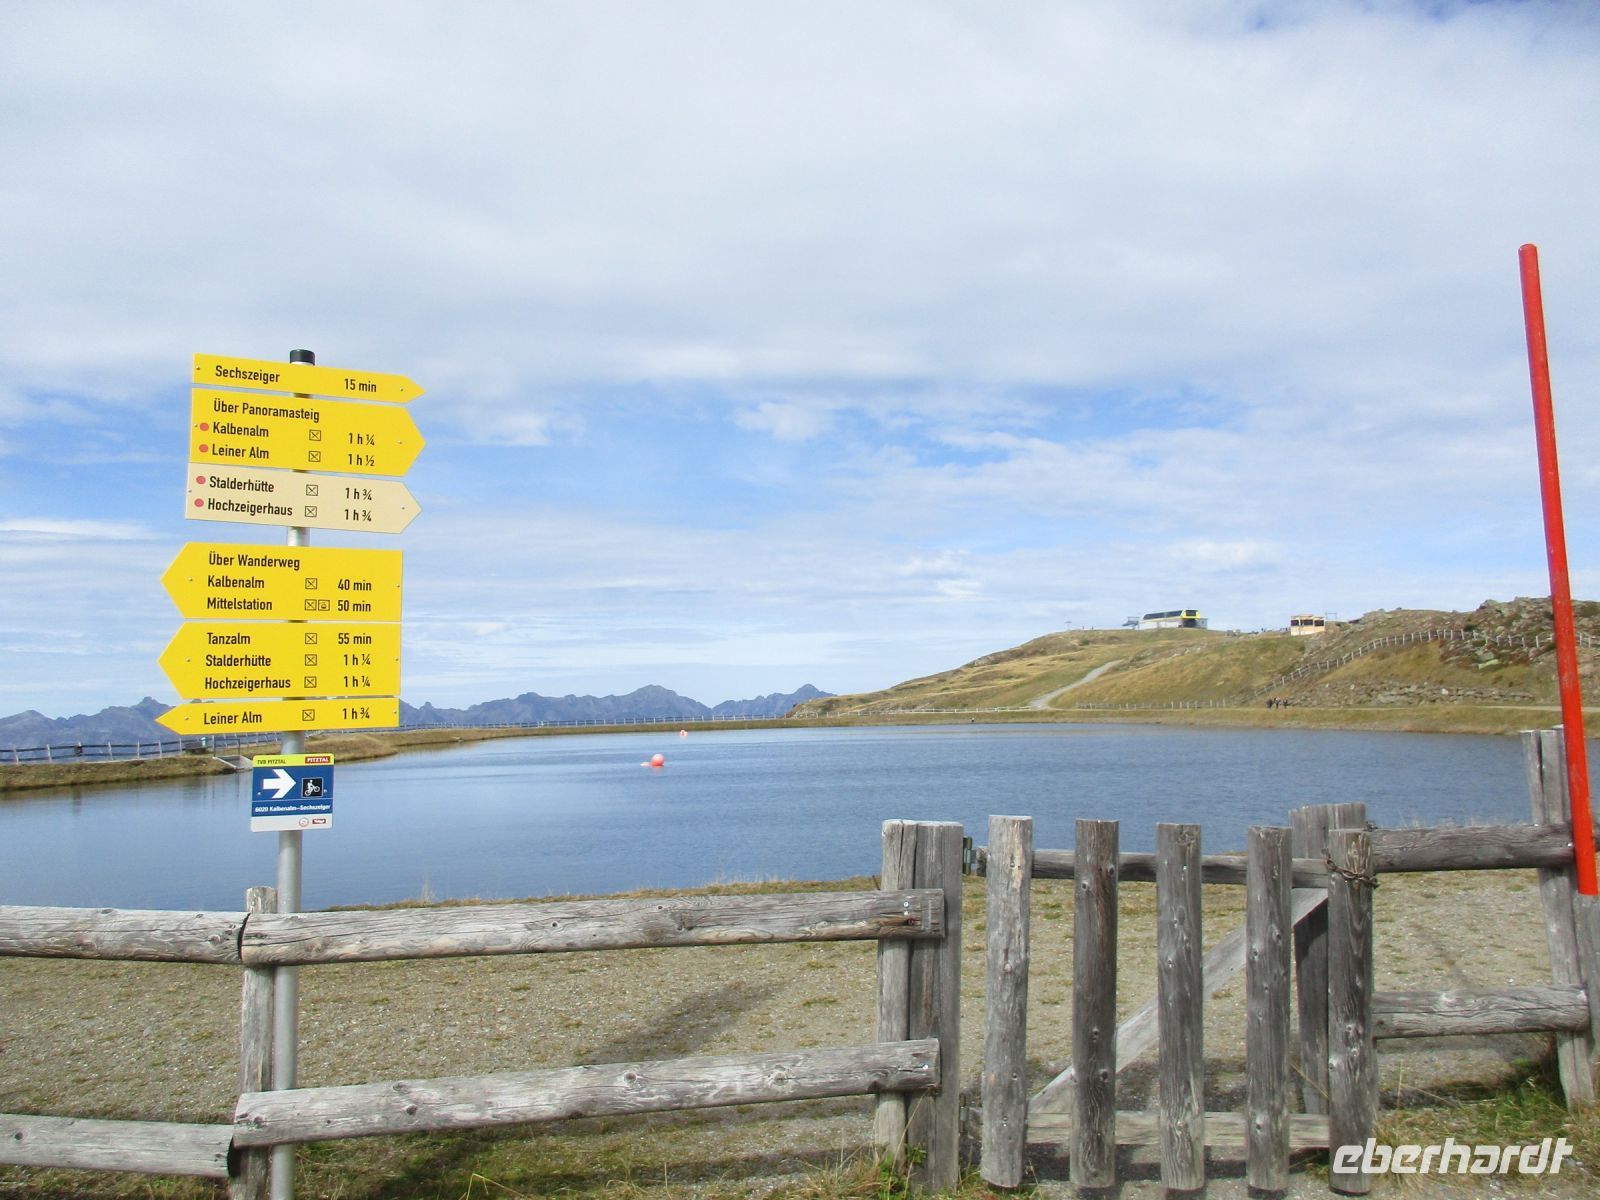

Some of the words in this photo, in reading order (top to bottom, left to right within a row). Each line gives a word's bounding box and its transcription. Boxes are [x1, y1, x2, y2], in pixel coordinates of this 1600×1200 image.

[216, 365, 280, 384] Sechszeiger
[345, 379, 355, 390] 15
[359, 381, 376, 392] min
[214, 398, 239, 413] Über
[242, 403, 319, 423] Panoramasteig
[213, 422, 268, 437] Kalbenalm
[348, 433, 354, 444] 1
[356, 433, 364, 444] h
[212, 444, 246, 457] Leiner
[249, 447, 269, 459] Alm
[347, 454, 353, 464] 1
[356, 454, 363, 465] h
[210, 476, 274, 492] Stalderhütte
[345, 488, 350, 499] 1
[353, 488, 360, 499] h
[208, 498, 292, 516] Hochzeigerhaus
[344, 509, 350, 520] 1
[352, 509, 360, 520] h
[209, 551, 234, 566] Über
[238, 554, 300, 571] Wanderweg
[208, 575, 264, 588] Kalbenalm
[338, 579, 350, 590] 40
[353, 580, 371, 591] min
[207, 597, 272, 610] Mittelstation
[338, 600, 349, 611] 50
[353, 600, 371, 612] min
[207, 632, 250, 644] Tanzalm
[338, 633, 349, 644] 55
[353, 633, 371, 644] min
[206, 654, 271, 666] Stalderhütte
[343, 654, 349, 666] 1
[352, 654, 359, 665] h
[205, 677, 291, 691] Hochzeigerhaus
[343, 676, 349, 687] 1
[352, 676, 359, 687] h
[204, 712, 239, 725] Leiner
[242, 711, 262, 723] Alm
[342, 708, 348, 720] 1
[351, 708, 358, 719] h
